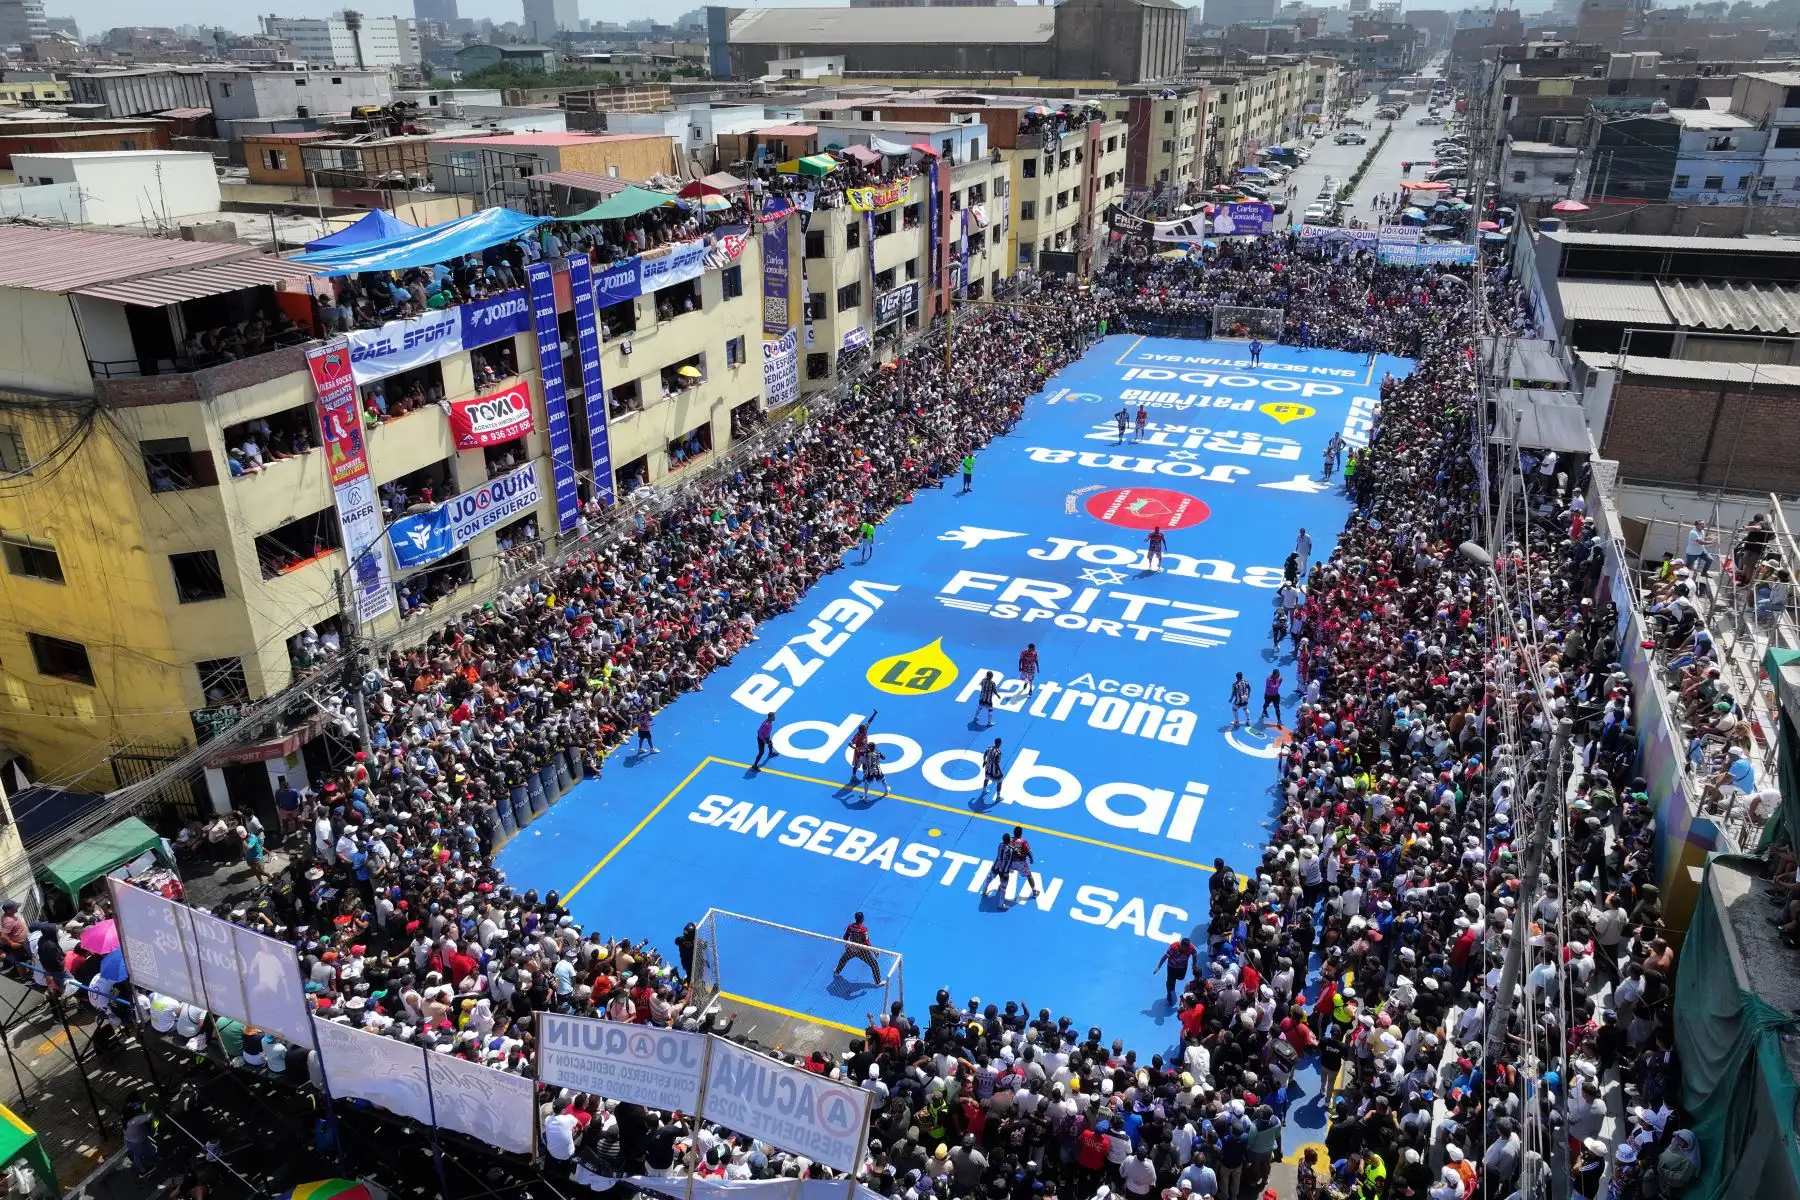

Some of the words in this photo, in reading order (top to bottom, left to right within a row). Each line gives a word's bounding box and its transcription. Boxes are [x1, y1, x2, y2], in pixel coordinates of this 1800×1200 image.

[1114, 213, 1144, 229] FRITZ
[1236, 204, 1259, 213] Carlos
[1382, 227, 1418, 235] JOAQUIN
[644, 260, 669, 278] GAEL
[672, 250, 703, 270] SPORT
[601, 268, 636, 293] Joma
[484, 297, 529, 326] Joma
[351, 338, 398, 363] GAEL
[403, 319, 456, 351] SPORT
[764, 362, 775, 374] ON
[1138, 353, 1177, 362] SAC
[1310, 366, 1358, 378] SAN
[1120, 368, 1345, 398] doobai
[466, 392, 525, 424] TOKIO
[1119, 388, 1257, 413] Patrona
[490, 430, 506, 441] 936
[506, 425, 519, 437] 337
[1084, 425, 1303, 461] FRITZ
[1025, 446, 1251, 484] Joma
[453, 466, 535, 524] JOAQUIN
[342, 505, 374, 525] MAFER
[457, 519, 480, 540] CON
[482, 491, 538, 526] ESFUERZO
[1026, 536, 1286, 590] Joma
[939, 569, 1240, 639] FRITZ
[989, 603, 1166, 643] SPORT
[879, 659, 943, 692] La
[1065, 670, 1191, 707] Aceite
[954, 667, 1199, 747] Patrona
[770, 712, 1210, 844] doobai
[688, 793, 787, 844] SAN
[1069, 884, 1190, 945] SAC
